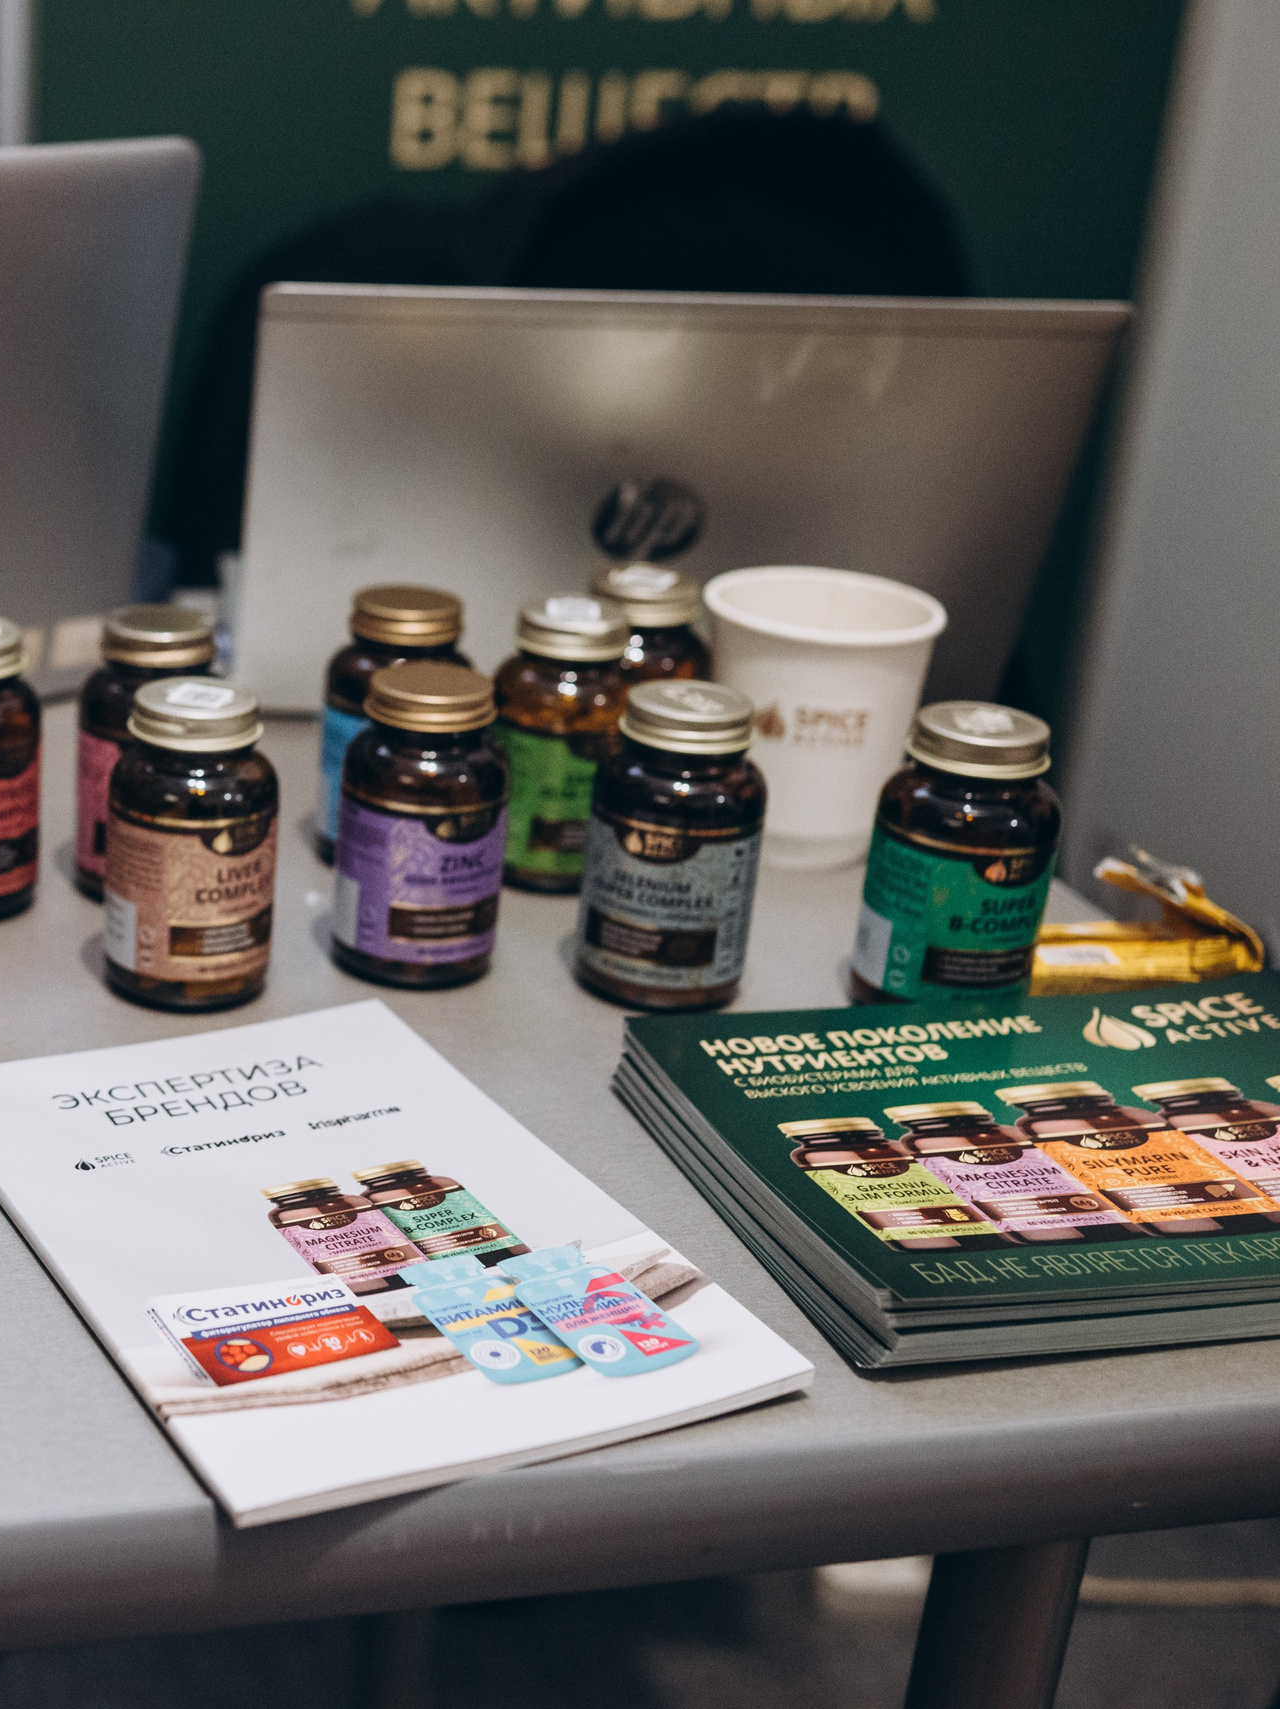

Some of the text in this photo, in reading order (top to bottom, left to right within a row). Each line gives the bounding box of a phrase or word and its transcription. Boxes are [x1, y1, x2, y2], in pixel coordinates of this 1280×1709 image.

[1131, 991, 1265, 1028] SPICE
[699, 1015, 1043, 1057] НОВОЕ ПОКОЛЕНИЕ
[1164, 1014, 1280, 1045] ACTIVE
[716, 1043, 949, 1076] НУТРИЕНТОВ
[51, 1054, 323, 1110] ЭКСПЕРТИЗА
[733, 1077, 748, 1088] С
[104, 1079, 308, 1126] БРЕНДОВ
[94, 1152, 132, 1164] SPICE
[973, 1149, 1010, 1159] SPICE
[1081, 1151, 1190, 1170] SILYMARIN
[1219, 1148, 1270, 1159] SKIN,
[860, 1162, 898, 1171] SPICE
[869, 1168, 903, 1176] ACTIVE
[1123, 1164, 1177, 1177] PURE
[956, 1167, 1062, 1183] MAGNESIUM
[856, 1181, 930, 1193] GARCINIA
[985, 1177, 1055, 1190] CITRATE
[843, 1192, 882, 1202] SLIM
[1074, 1199, 1096, 1208] Mg
[412, 1209, 454, 1223] SUPER
[1171, 1208, 1203, 1216] VEGGIE
[1203, 1204, 1244, 1214] CAPSULES
[320, 1213, 349, 1224] SPICE
[403, 1212, 480, 1234] B-COMPLEX
[1066, 1215, 1105, 1224] CAPSULES
[304, 1225, 383, 1246] MAGNESIUM
[325, 1235, 376, 1251] CITRATE
[996, 1256, 1040, 1279] НЕ
[1032, 1246, 1183, 1278] ЯВЛЯЕТСЯ
[185, 1287, 347, 1322] Статинориз
[545, 1292, 643, 1324] ВИТАМИНЫ
